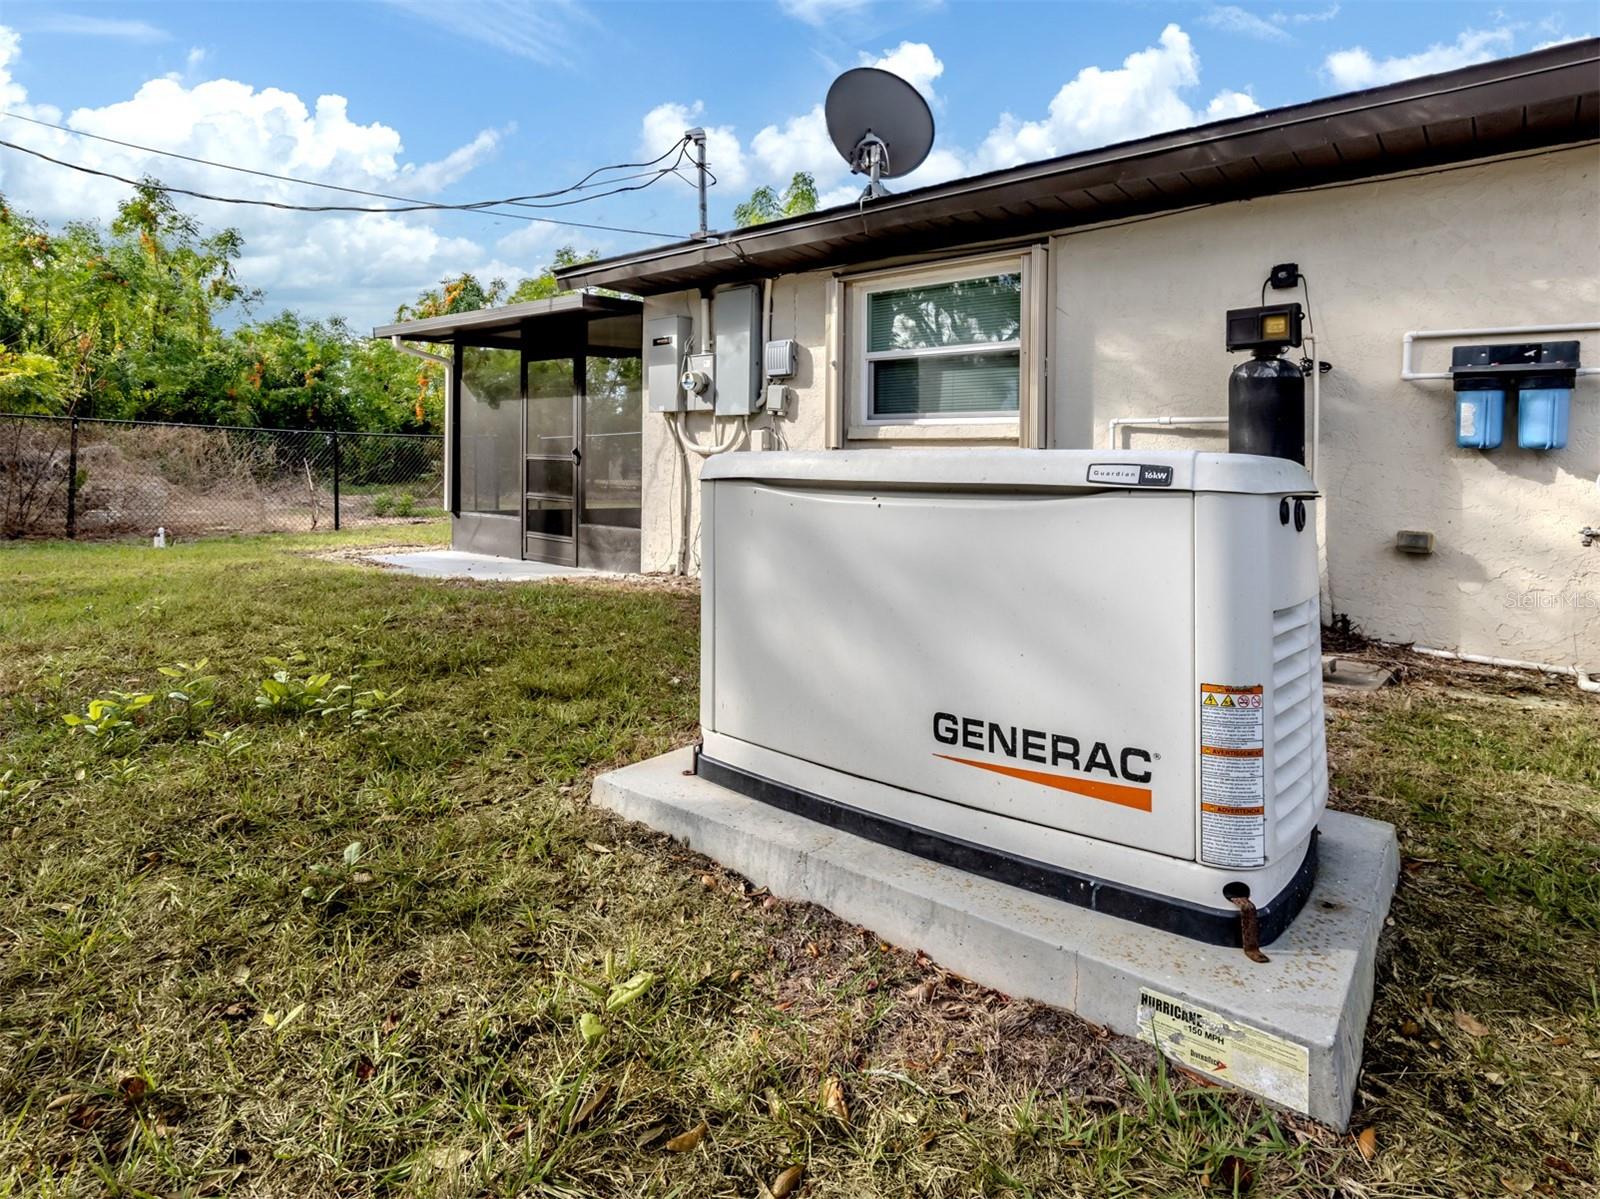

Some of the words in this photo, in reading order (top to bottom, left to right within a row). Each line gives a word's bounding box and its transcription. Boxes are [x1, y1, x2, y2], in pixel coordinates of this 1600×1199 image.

[1144, 471, 1168, 480] 16kW
[933, 711, 1153, 784] GENERAC
[1140, 992, 1203, 1028] HURRICANE
[1187, 1025, 1203, 1037] 150
[1204, 1032, 1226, 1045] MPH
